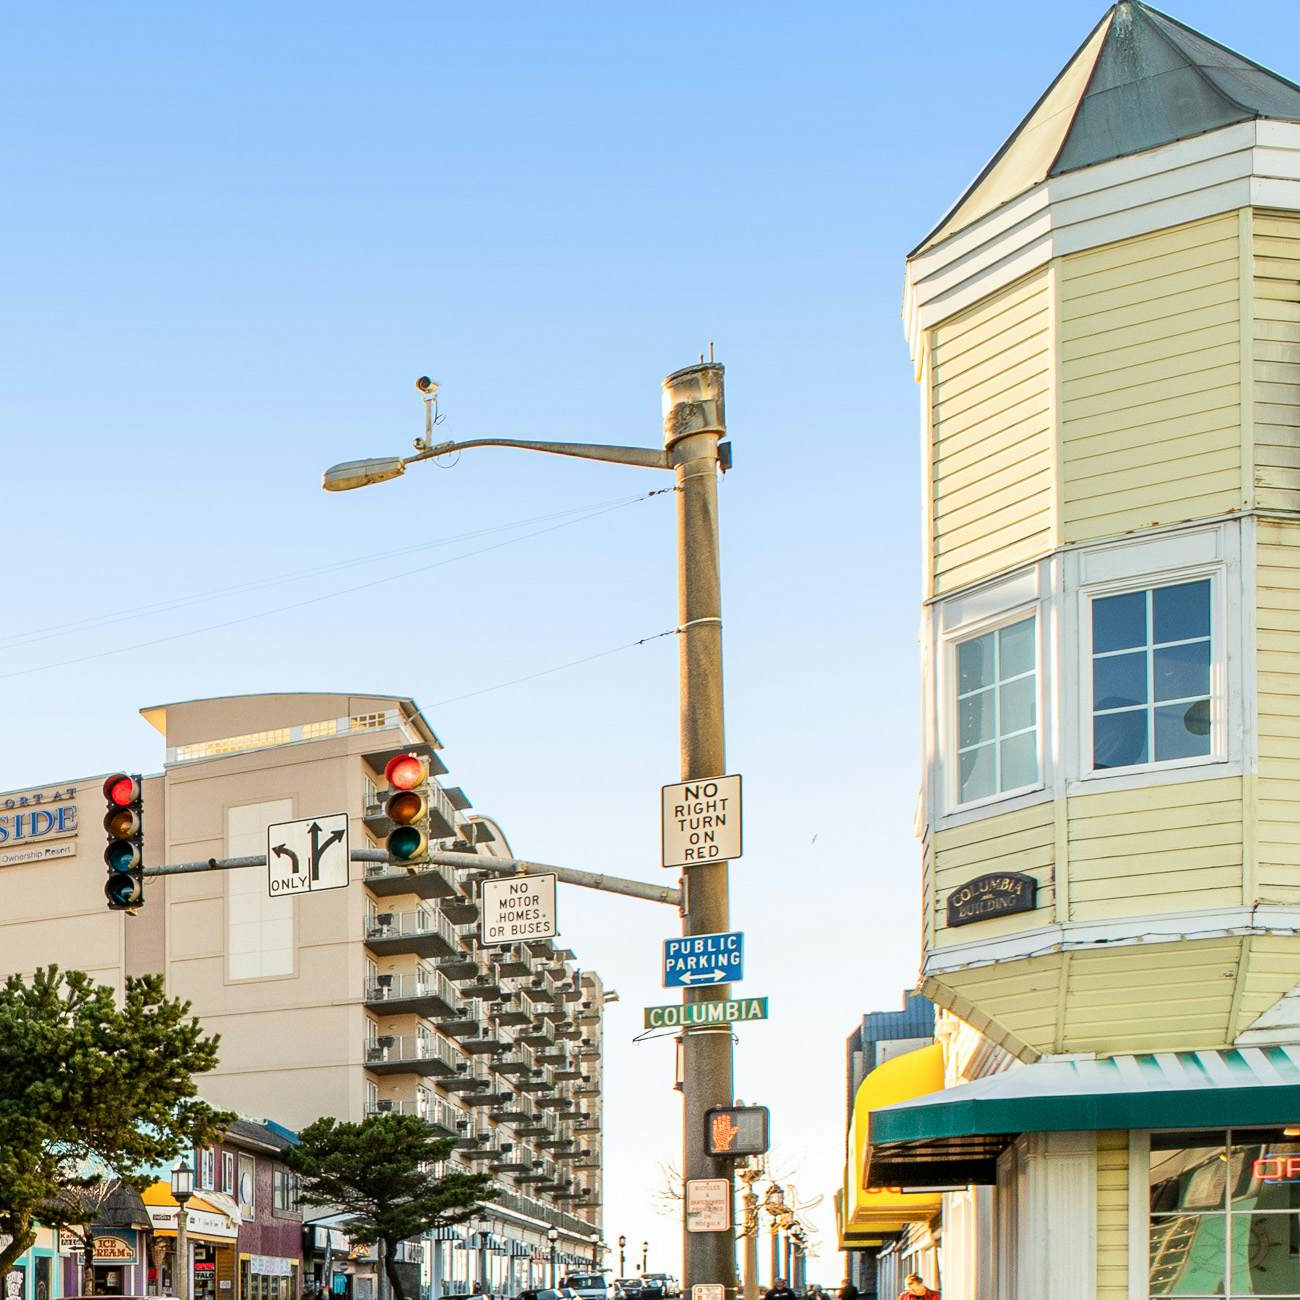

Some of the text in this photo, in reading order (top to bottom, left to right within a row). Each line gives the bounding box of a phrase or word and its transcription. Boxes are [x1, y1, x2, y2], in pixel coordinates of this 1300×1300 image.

[53, 787, 77, 801] AT
[685, 783, 718, 801] NO
[674, 798, 728, 817] RIGHT
[678, 814, 726, 832] TURN
[689, 830, 714, 845] ON
[1, 850, 43, 863] Ownership
[44, 846, 71, 857] Resort
[685, 845, 719, 861] RED
[271, 876, 308, 891] ONLY
[510, 883, 528, 894] NO
[952, 877, 1024, 907] COLUMBIA
[499, 895, 540, 909] MOTOR
[959, 894, 1017, 917] BUILDING
[498, 908, 539, 922] HOMES
[489, 922, 550, 938] OR BUSES
[670, 936, 737, 955] PUBLIC
[666, 952, 740, 971] PARKING
[649, 1000, 763, 1027] COLUMBIA
[98, 1239, 117, 1248] ICE
